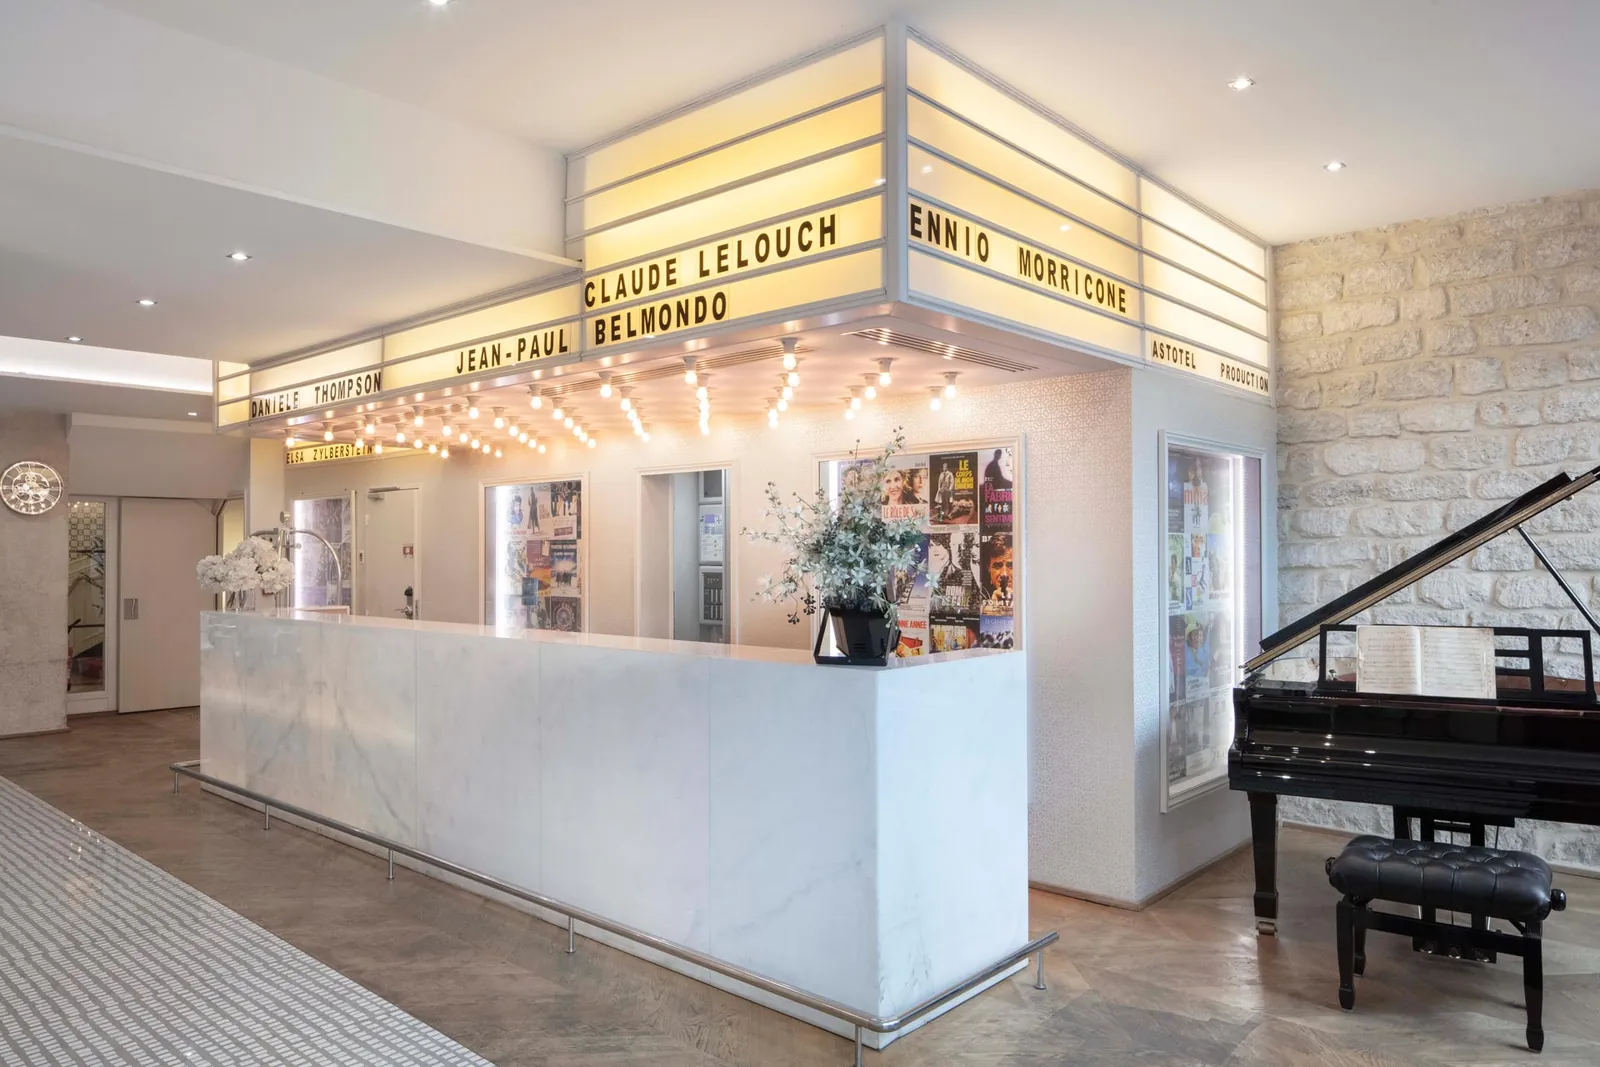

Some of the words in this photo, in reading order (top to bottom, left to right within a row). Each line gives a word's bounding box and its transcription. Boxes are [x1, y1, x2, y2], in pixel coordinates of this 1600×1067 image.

[585, 257, 677, 308] CLAUDE
[699, 213, 836, 278] LELOUCH
[910, 203, 989, 263] ENNIO
[1019, 247, 1126, 313] MORRICONE
[457, 328, 568, 374] JEAN-PAUL
[595, 291, 727, 346] BELMONDO
[1152, 340, 1197, 369] ASTOTEL
[1220, 362, 1269, 393] PRODUCTION
[252, 391, 299, 418] DANIELE
[314, 372, 382, 405] THOMPSON
[286, 450, 304, 464] ELSA
[313, 443, 373, 461] ZYLBERSTEIN
[959, 459, 970, 471] LE
